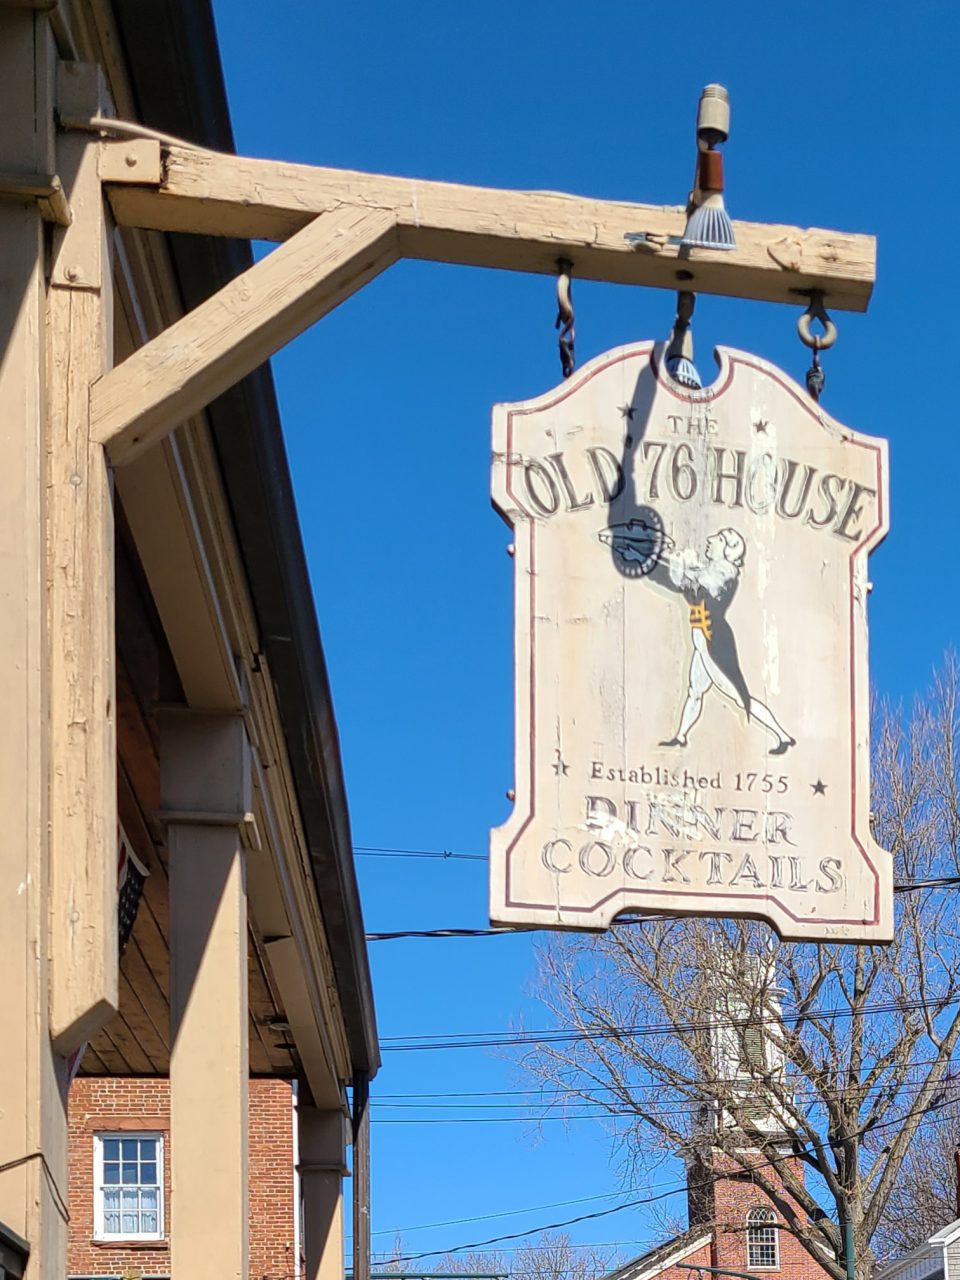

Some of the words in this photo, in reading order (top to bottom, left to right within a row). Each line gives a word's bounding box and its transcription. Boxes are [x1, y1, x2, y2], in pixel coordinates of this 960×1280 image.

[667, 415, 718, 437] THE
[521, 446, 625, 518] OLD
[708, 446, 877, 541] HOUSE
[590, 760, 722, 790] Established
[734, 772, 790, 794] 1755
[584, 795, 799, 847] DINNER
[540, 837, 846, 894] COCKTAILS
